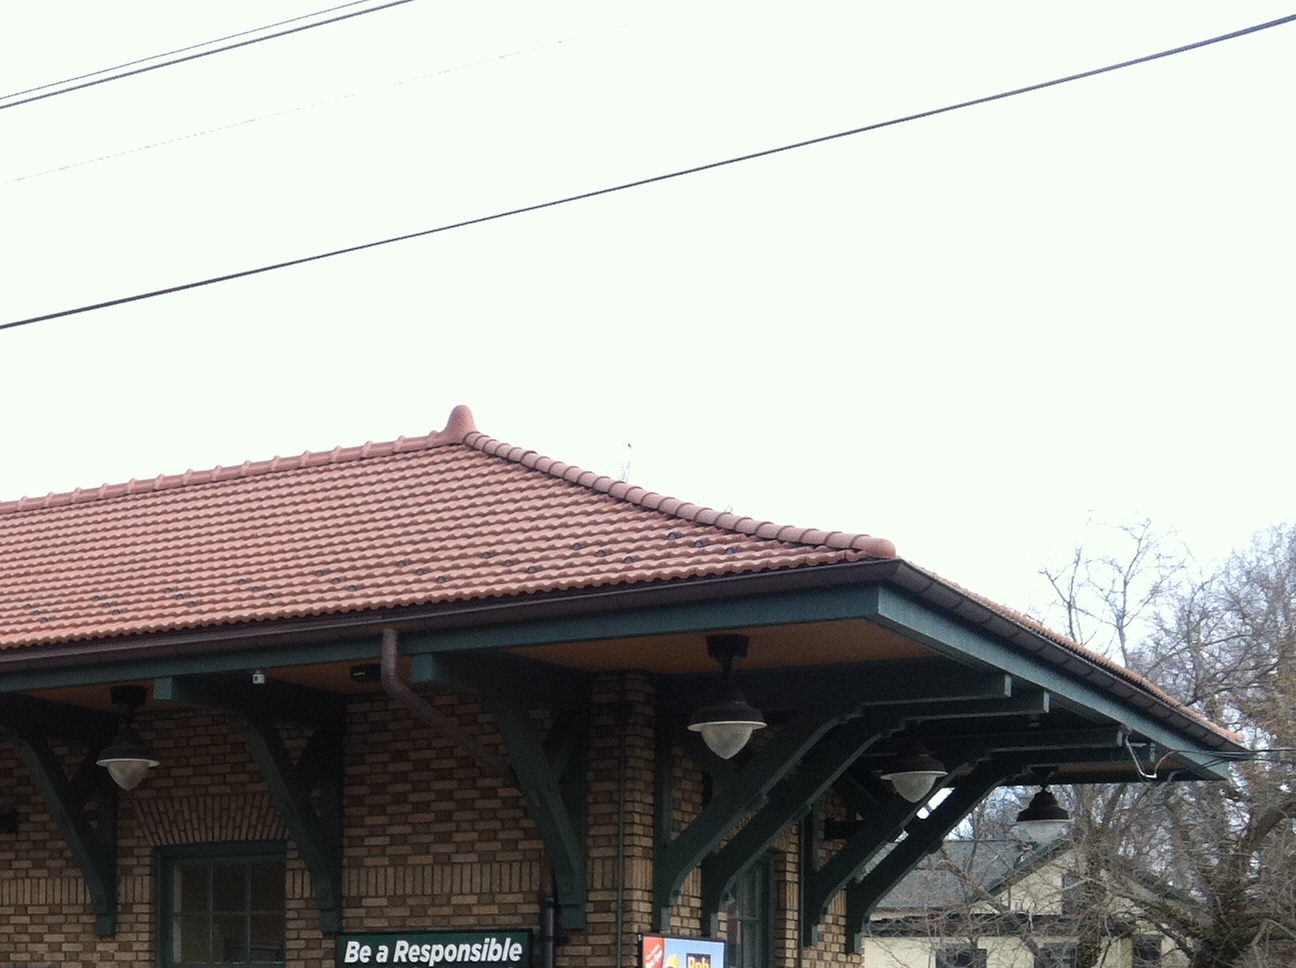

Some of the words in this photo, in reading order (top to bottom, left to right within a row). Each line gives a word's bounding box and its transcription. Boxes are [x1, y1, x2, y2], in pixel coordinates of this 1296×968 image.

[344, 941, 372, 963] Be
[375, 944, 389, 963] a
[393, 937, 523, 967] Responsible
